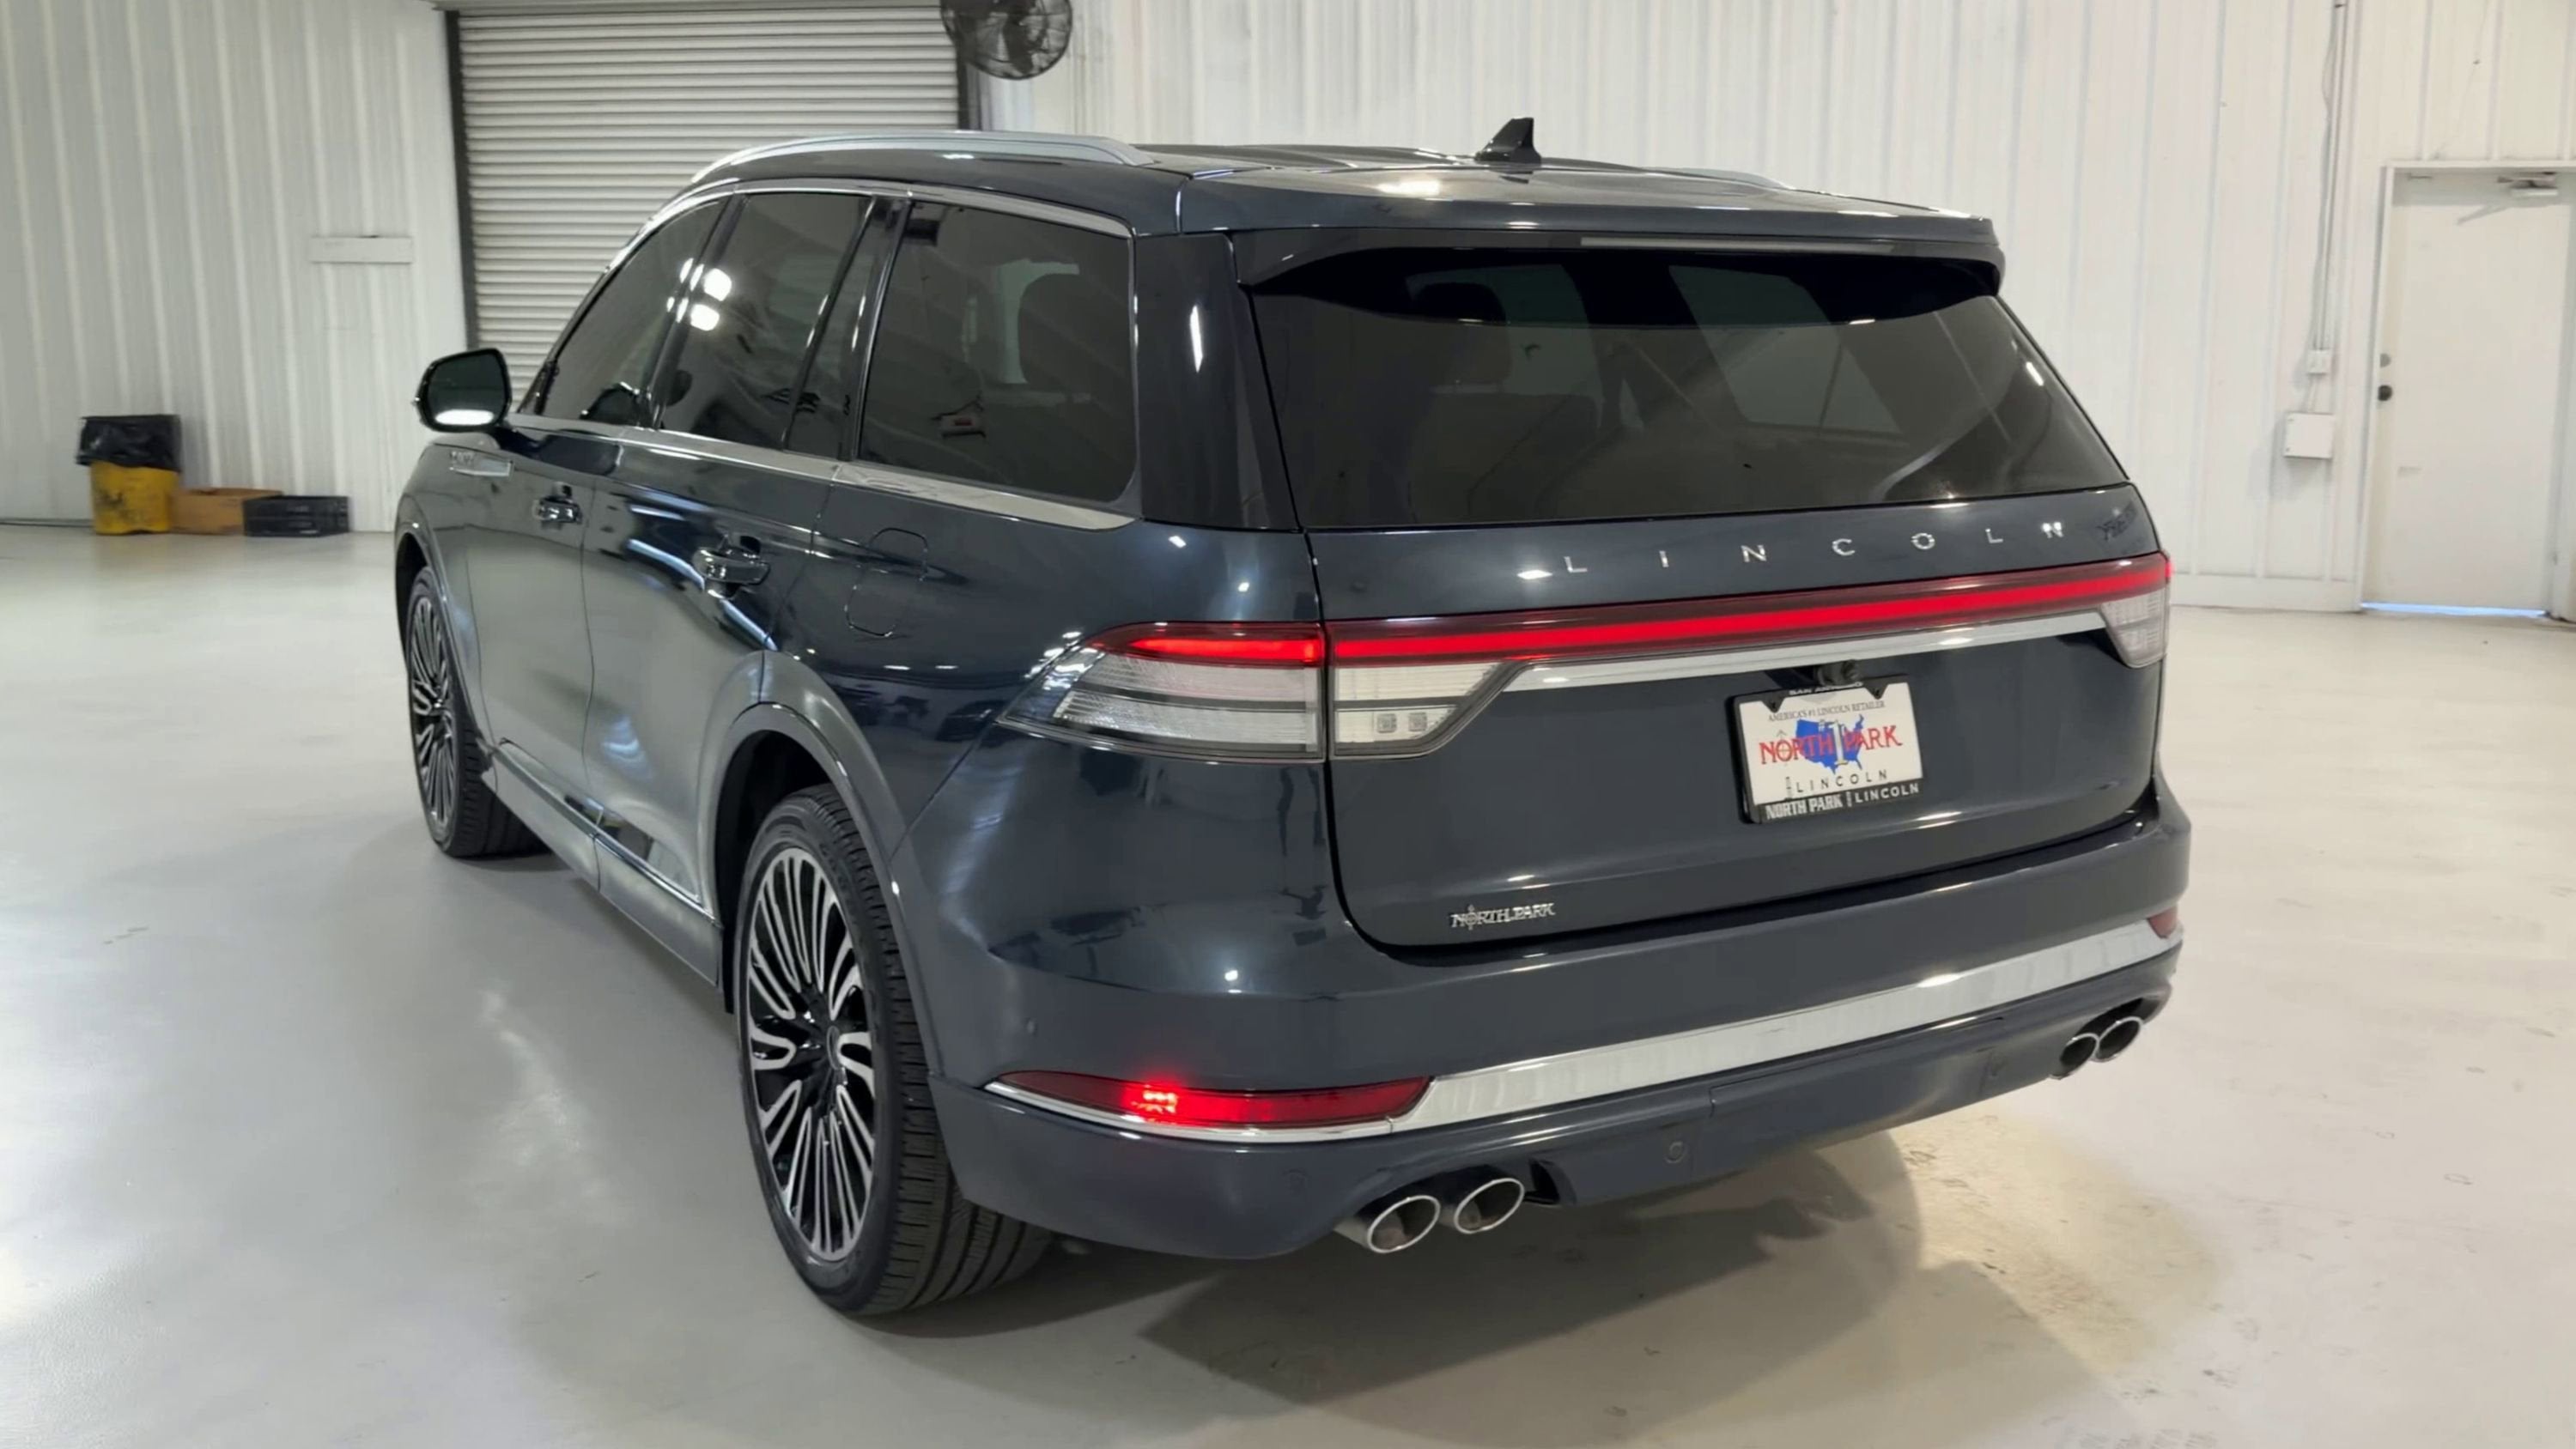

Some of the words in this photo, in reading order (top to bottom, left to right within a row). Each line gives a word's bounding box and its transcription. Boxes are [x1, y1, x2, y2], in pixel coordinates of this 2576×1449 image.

[1564, 521, 2065, 574] LINCOLN
[1815, 704, 1850, 717] LINCOLN
[1852, 700, 1885, 712] RETAILER
[1759, 731, 1835, 765] NORTH
[1844, 725, 1903, 752] PARK
[1795, 769, 1887, 793] LINCOLN
[1765, 798, 1807, 820] NORTH
[1808, 793, 1844, 813] PARK
[1855, 782, 1919, 803] LINCOLN
[1450, 906, 1511, 929] NORTH
[1512, 902, 1556, 920] PARK
